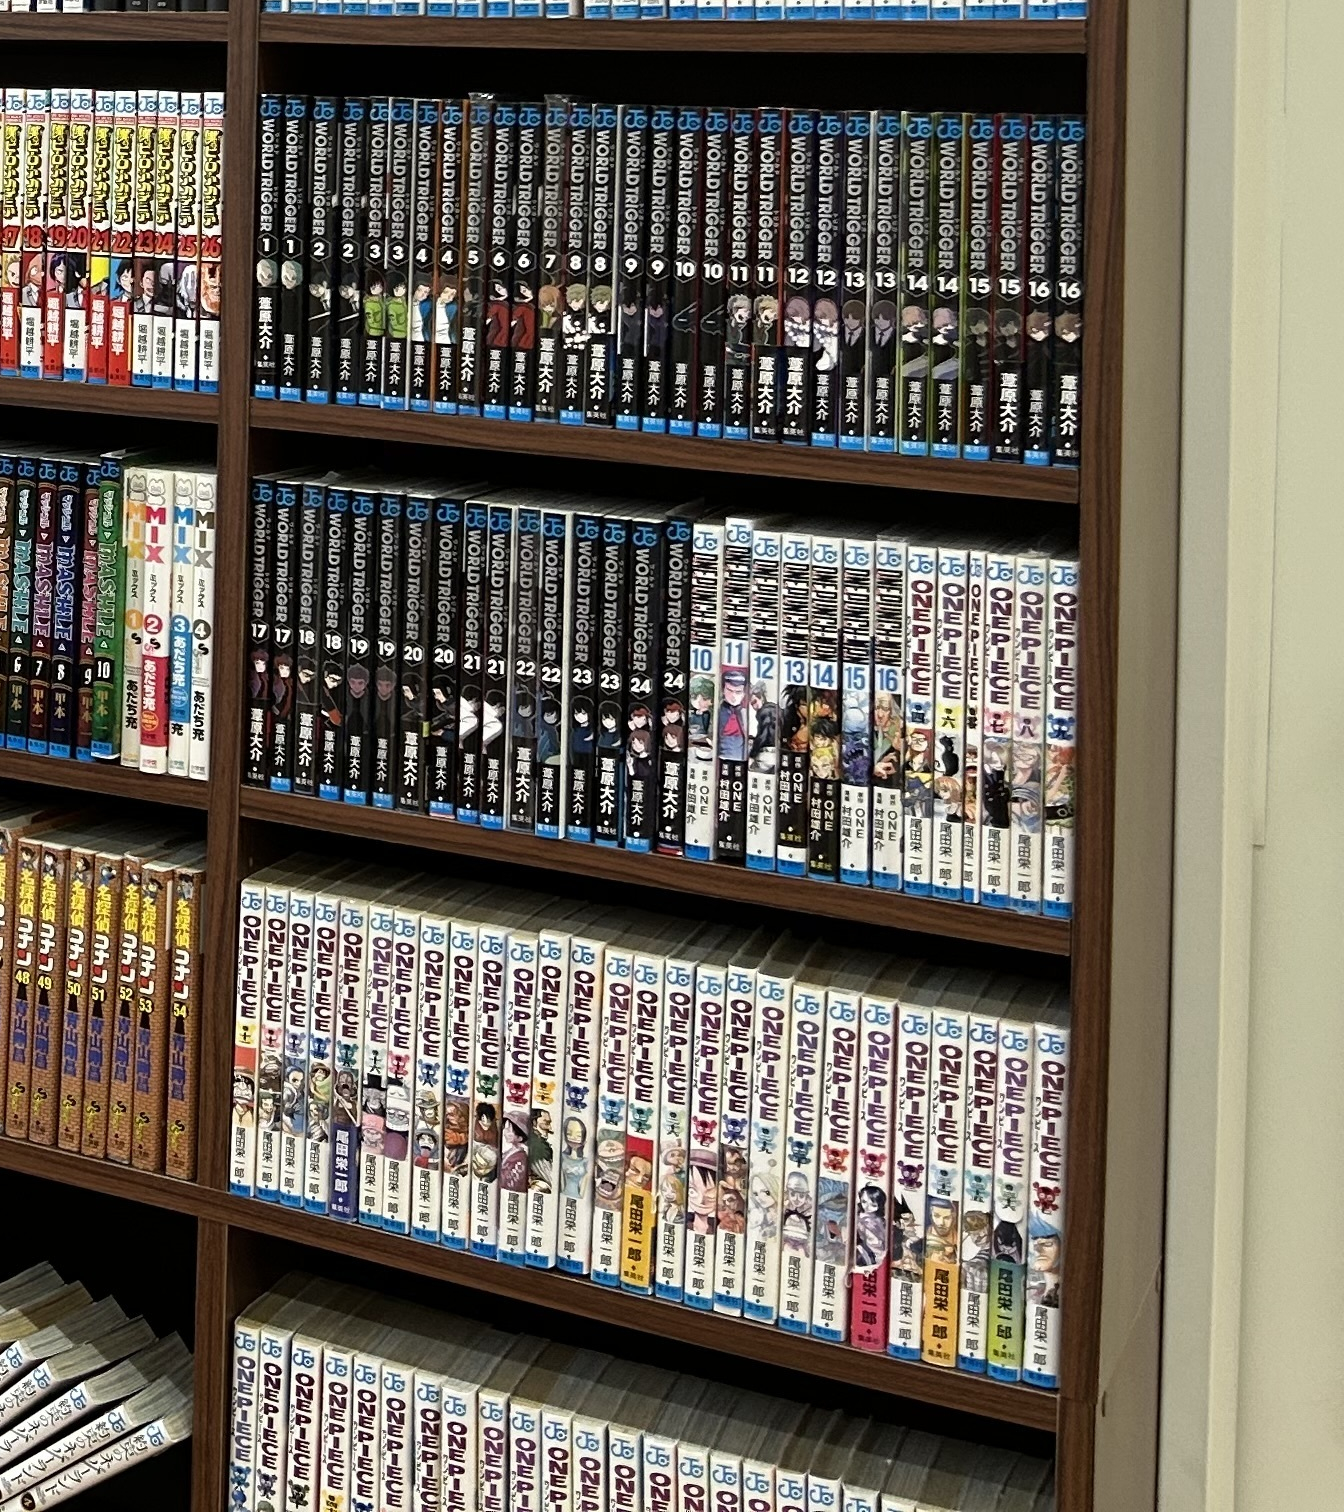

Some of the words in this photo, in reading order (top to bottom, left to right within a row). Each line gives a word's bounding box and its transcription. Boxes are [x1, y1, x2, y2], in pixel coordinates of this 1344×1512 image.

[285, 120, 299, 172] WORLD
[418, 126, 432, 178] WORLD
[790, 137, 806, 193] WORLD
[937, 142, 955, 199] WORLD
[1060, 145, 1077, 203] WORLD
[284, 172, 298, 233] TRIGGER
[416, 179, 430, 242] TRIGGER
[287, 240, 294, 253] 1
[789, 194, 805, 261] TRIGGER
[938, 201, 954, 269] TRIGGER
[1060, 205, 1077, 275] TRIGGER
[416, 249, 428, 262] 4
[788, 268, 809, 284] 12
[937, 276, 958, 292] 14
[1059, 282, 1081, 298] 16
[174, 507, 193, 564] MIX
[195, 511, 214, 568] MIX
[943, 583, 965, 626] ONE
[1054, 592, 1078, 636] ONE
[97, 661, 110, 679] 10
[692, 648, 712, 672] 10
[725, 642, 744, 664] 11
[785, 661, 805, 683] 13
[814, 663, 835, 687] 14
[942, 628, 964, 700] PIECE
[1054, 638, 1076, 710] PIECE
[878, 668, 898, 691] 16
[192, 690, 205, 741] あだち充
[15, 972, 30, 984] 48
[67, 982, 81, 996] 50
[173, 1005, 187, 1018] 54
[637, 989, 658, 1033] ONE
[762, 1006, 784, 1050] ONE
[635, 1033, 657, 1103] PIECE
[832, 1027, 855, 1070] ONE
[937, 1045, 961, 1088] ONE
[759, 1052, 782, 1121] PIECE
[1040, 1060, 1065, 1105] ONE
[829, 1071, 851, 1144] PIECE
[936, 1090, 959, 1163] PIECE
[1039, 1107, 1062, 1181] PIECE
